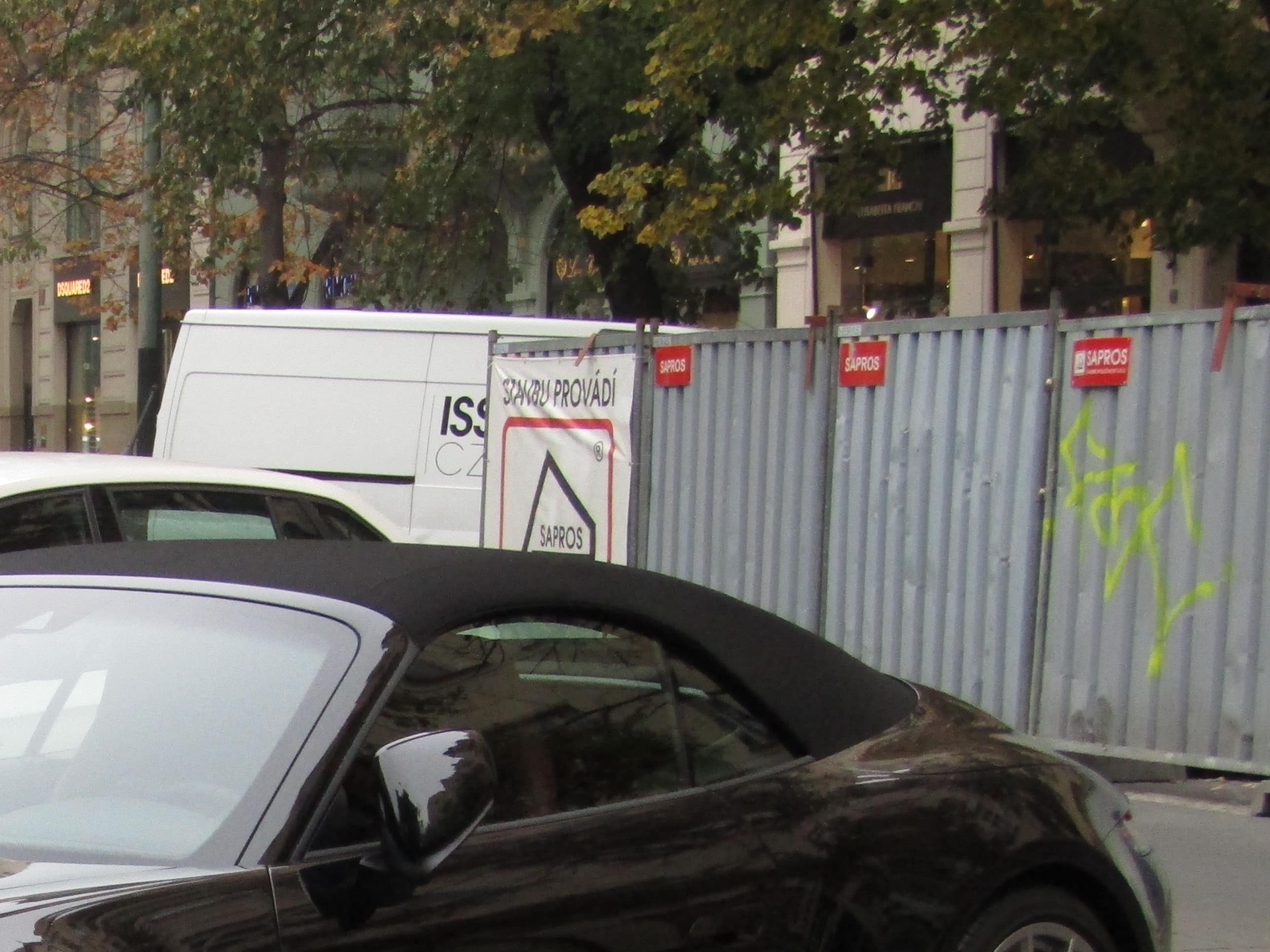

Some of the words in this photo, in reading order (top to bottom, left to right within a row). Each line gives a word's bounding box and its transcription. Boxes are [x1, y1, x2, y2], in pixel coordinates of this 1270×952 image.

[659, 358, 686, 375] SAPROS
[844, 356, 880, 372] SAPROS
[1086, 348, 1128, 367] SAPROS
[502, 378, 550, 406] STAVBU
[554, 368, 618, 408] PROVÁDÍ
[540, 524, 583, 549] SAPROS
